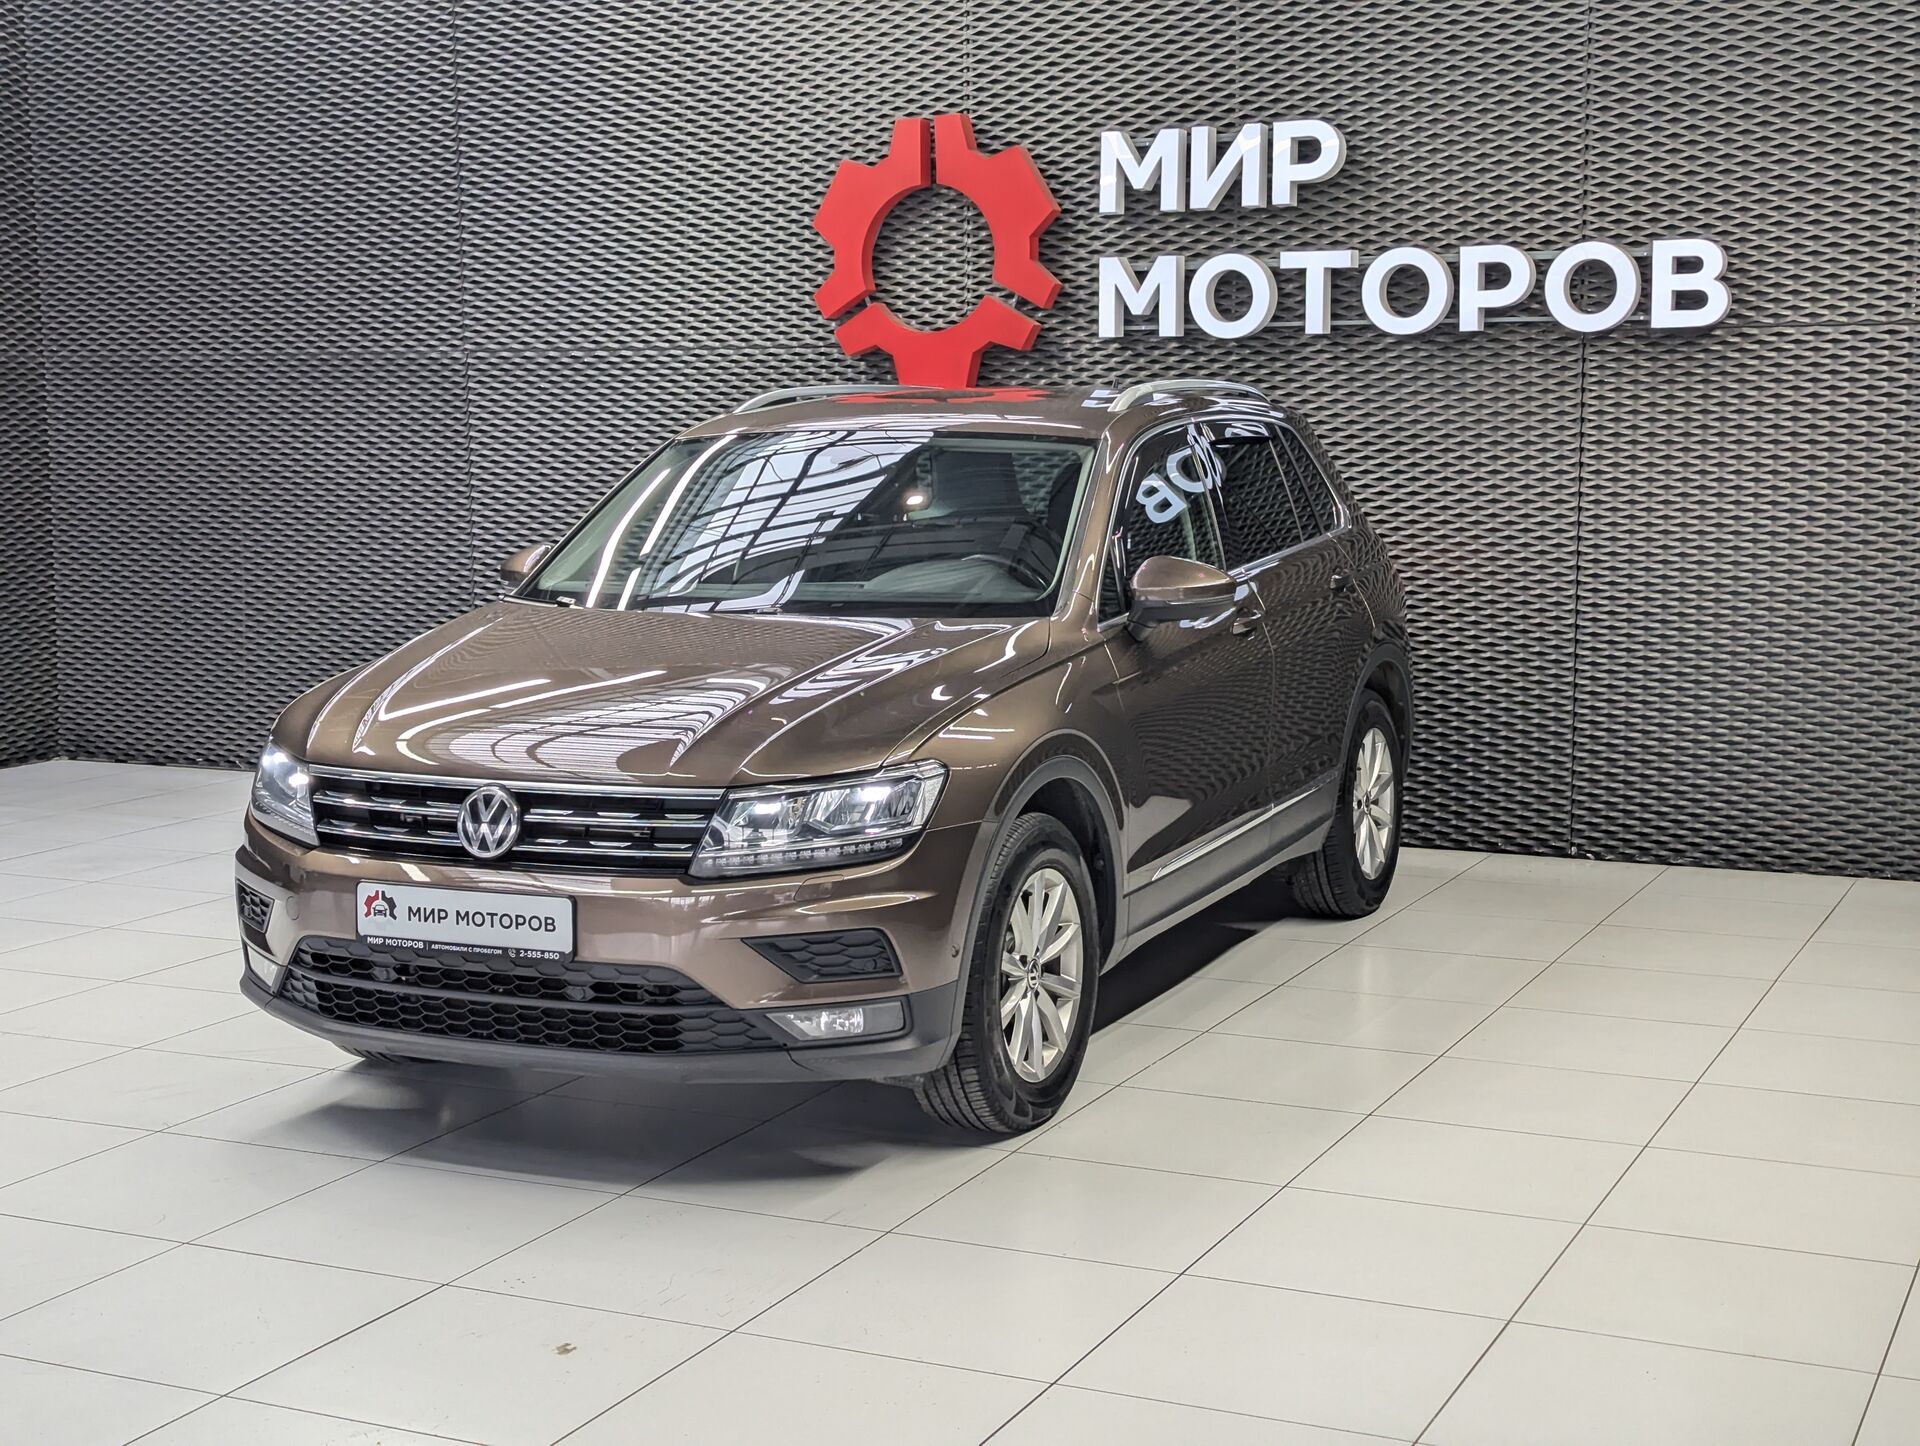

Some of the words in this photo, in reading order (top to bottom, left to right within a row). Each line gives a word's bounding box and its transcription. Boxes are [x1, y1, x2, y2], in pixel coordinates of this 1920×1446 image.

[1098, 119, 1346, 215] МИР
[1098, 238, 1732, 339] МОТОРОВ
[407, 905, 449, 924] МИР
[455, 910, 557, 933] МОТОРОВ
[367, 936, 384, 945] МИР
[385, 938, 424, 949] МОТОРОВ
[431, 944, 467, 952] АВТОМОБИЛИ
[519, 950, 560, 960] 2-555-850
